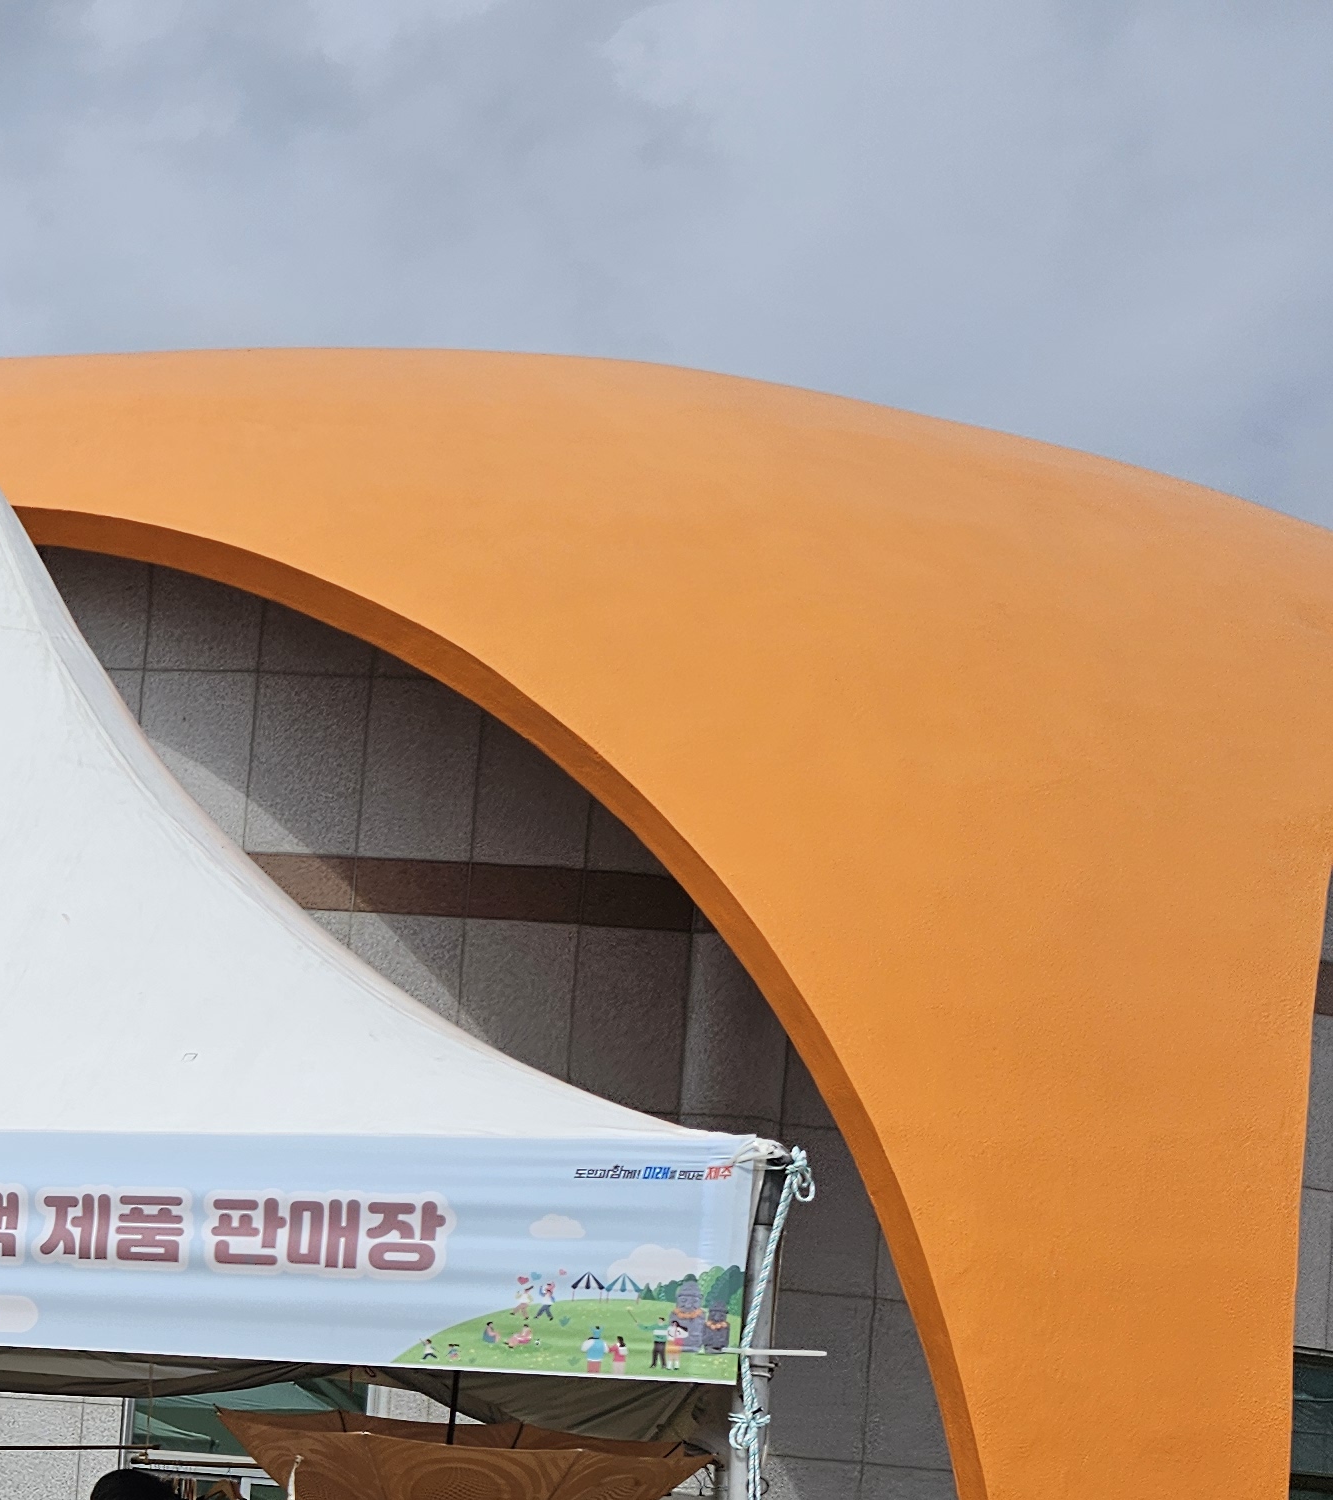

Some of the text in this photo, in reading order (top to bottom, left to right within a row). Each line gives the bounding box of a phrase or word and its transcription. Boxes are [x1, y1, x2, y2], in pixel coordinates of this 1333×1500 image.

[704, 1165, 733, 1181] 제주
[39, 1193, 184, 1263] 제품
[210, 1197, 447, 1272] 판매장
